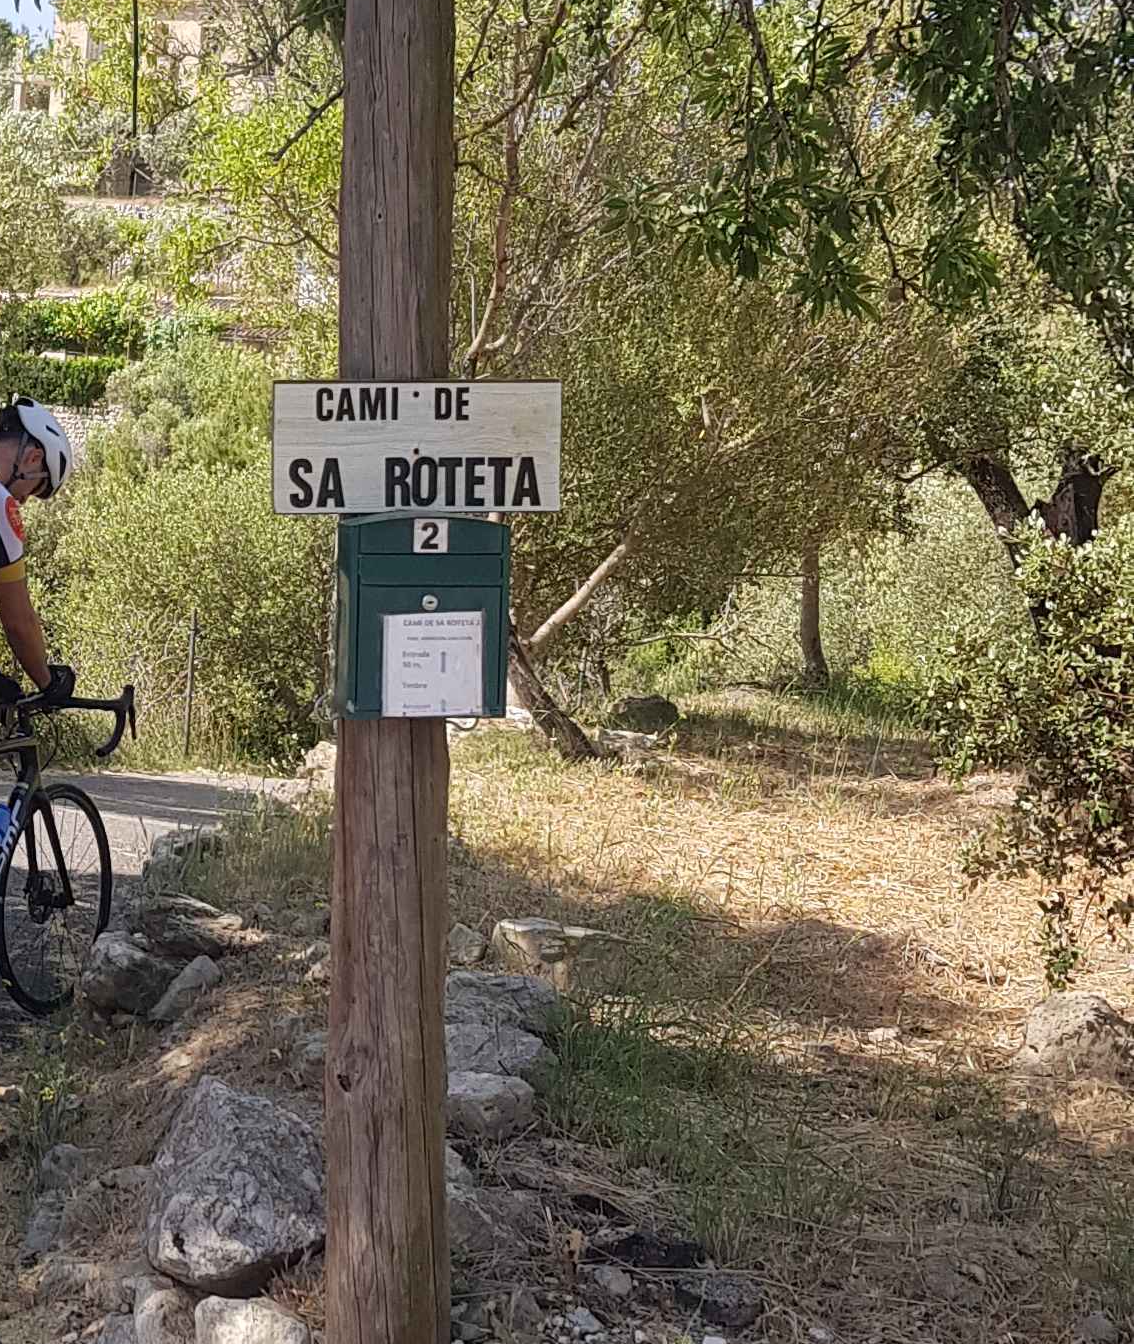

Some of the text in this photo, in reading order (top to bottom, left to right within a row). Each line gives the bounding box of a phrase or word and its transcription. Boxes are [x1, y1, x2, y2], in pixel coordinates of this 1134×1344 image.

[316, 387, 469, 421] CAMI DE
[288, 456, 541, 508] SA ROTETA
[421, 522, 439, 550] 2
